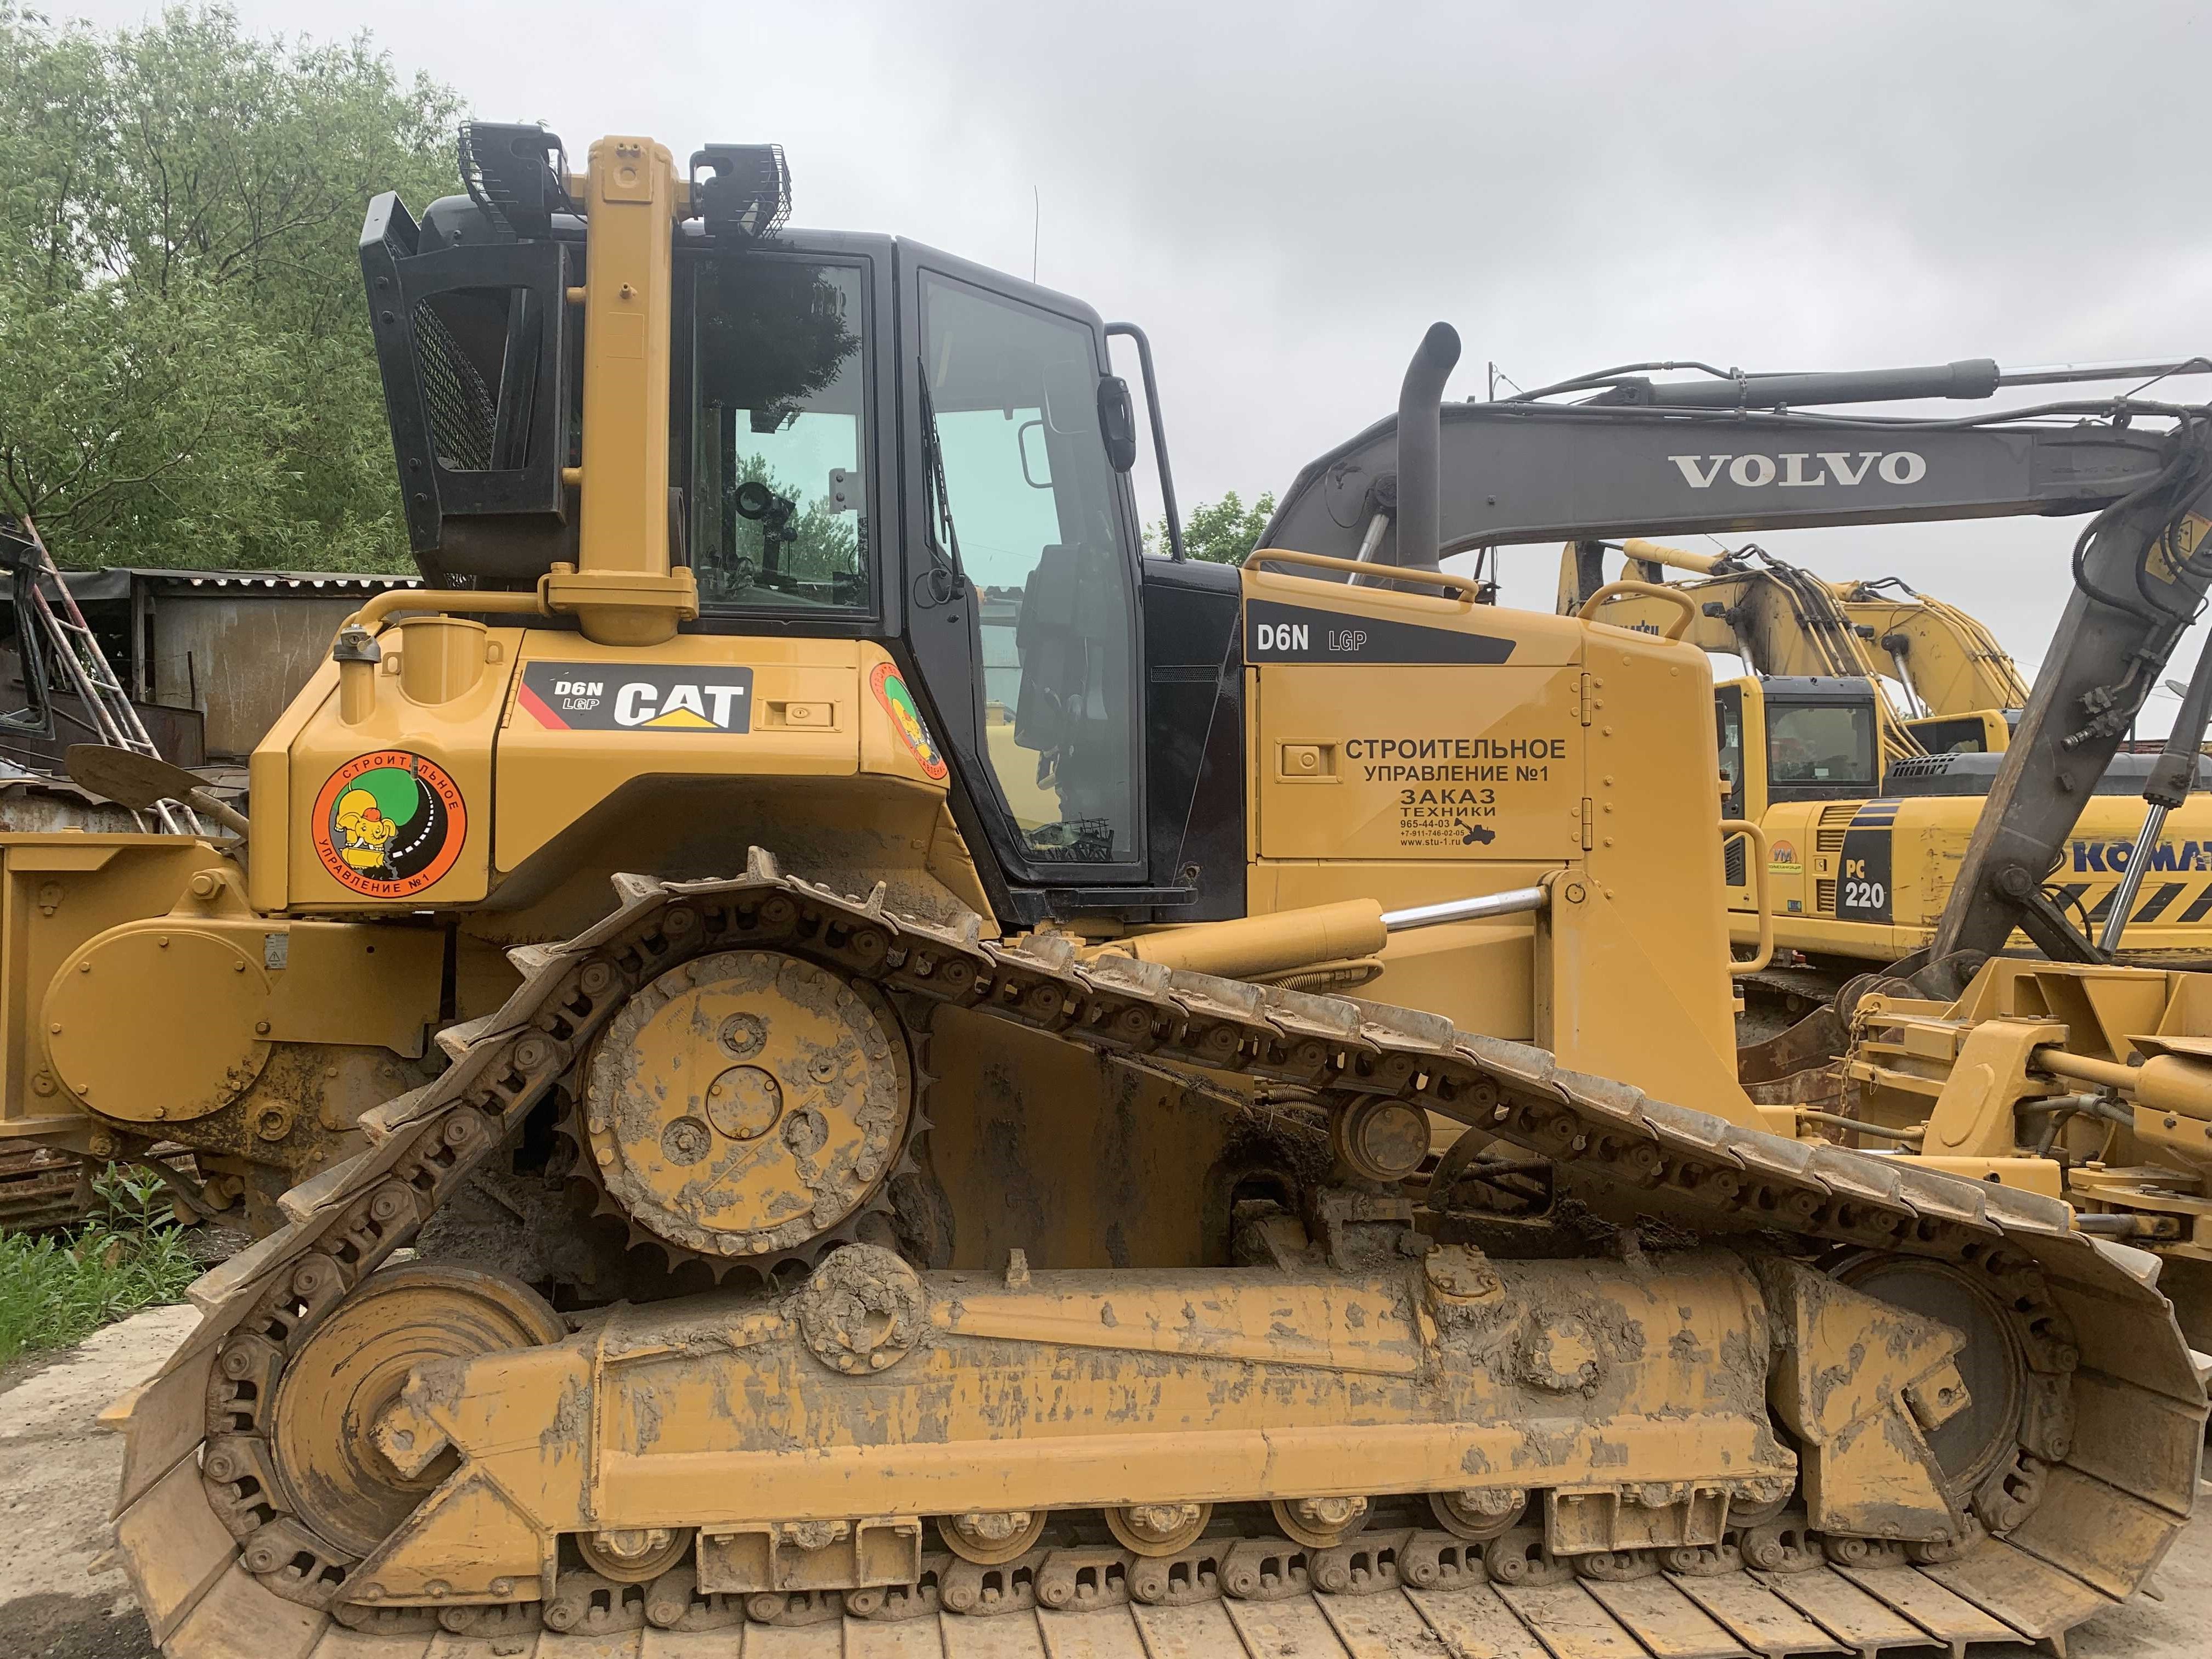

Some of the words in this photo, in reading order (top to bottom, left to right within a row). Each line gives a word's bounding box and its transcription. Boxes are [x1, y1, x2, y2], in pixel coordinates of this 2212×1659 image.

[1668, 451, 1927, 488] VOLVO
[1257, 624, 1309, 651] D6N
[1329, 630, 1367, 651] LGP
[554, 681, 604, 696] D6N
[562, 698, 600, 710] LGP
[614, 682, 744, 729] CAT
[1346, 739, 1566, 759] СТРОИТЕЛЬНОЕ
[342, 755, 459, 810] СТРОИТЛЬНОЕ
[1364, 765, 1509, 782] УПРАВЛЕНИЕ
[1516, 765, 1548, 782] №1
[1400, 788, 1496, 805] ЗАКАЗ
[1400, 807, 1496, 817] ТЕХНИКИ
[1400, 820, 1450, 828] 965-44-03
[1400, 838, 1461, 846] www.stu-1.ru
[319, 838, 402, 893] УПРАВЛЕНИЕ
[1846, 859, 1865, 879] PC
[1845, 881, 1885, 909] 220
